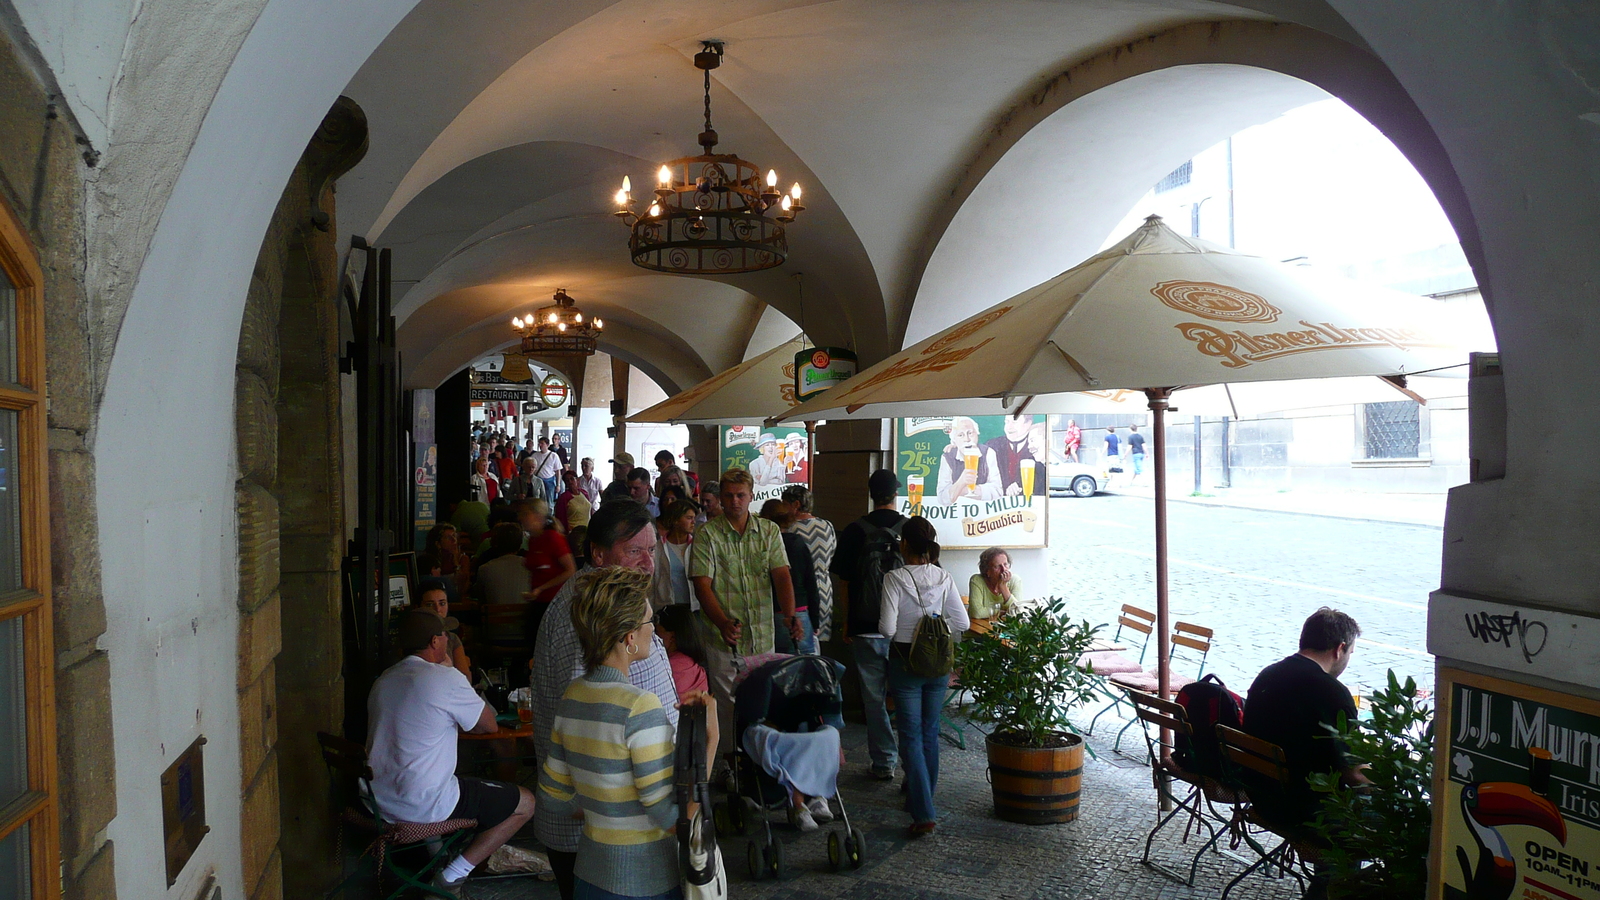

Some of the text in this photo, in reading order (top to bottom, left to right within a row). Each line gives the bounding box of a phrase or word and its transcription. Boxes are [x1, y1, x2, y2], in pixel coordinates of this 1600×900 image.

[471, 389, 526, 400] RESTAURANT
[900, 450, 931, 478] 25
[901, 500, 958, 519] PÁNOVÉ
[962, 503, 979, 517] TO
[967, 523, 976, 536] U
[1456, 688, 1501, 749] J.J.
[1525, 841, 1589, 877] OPEN
